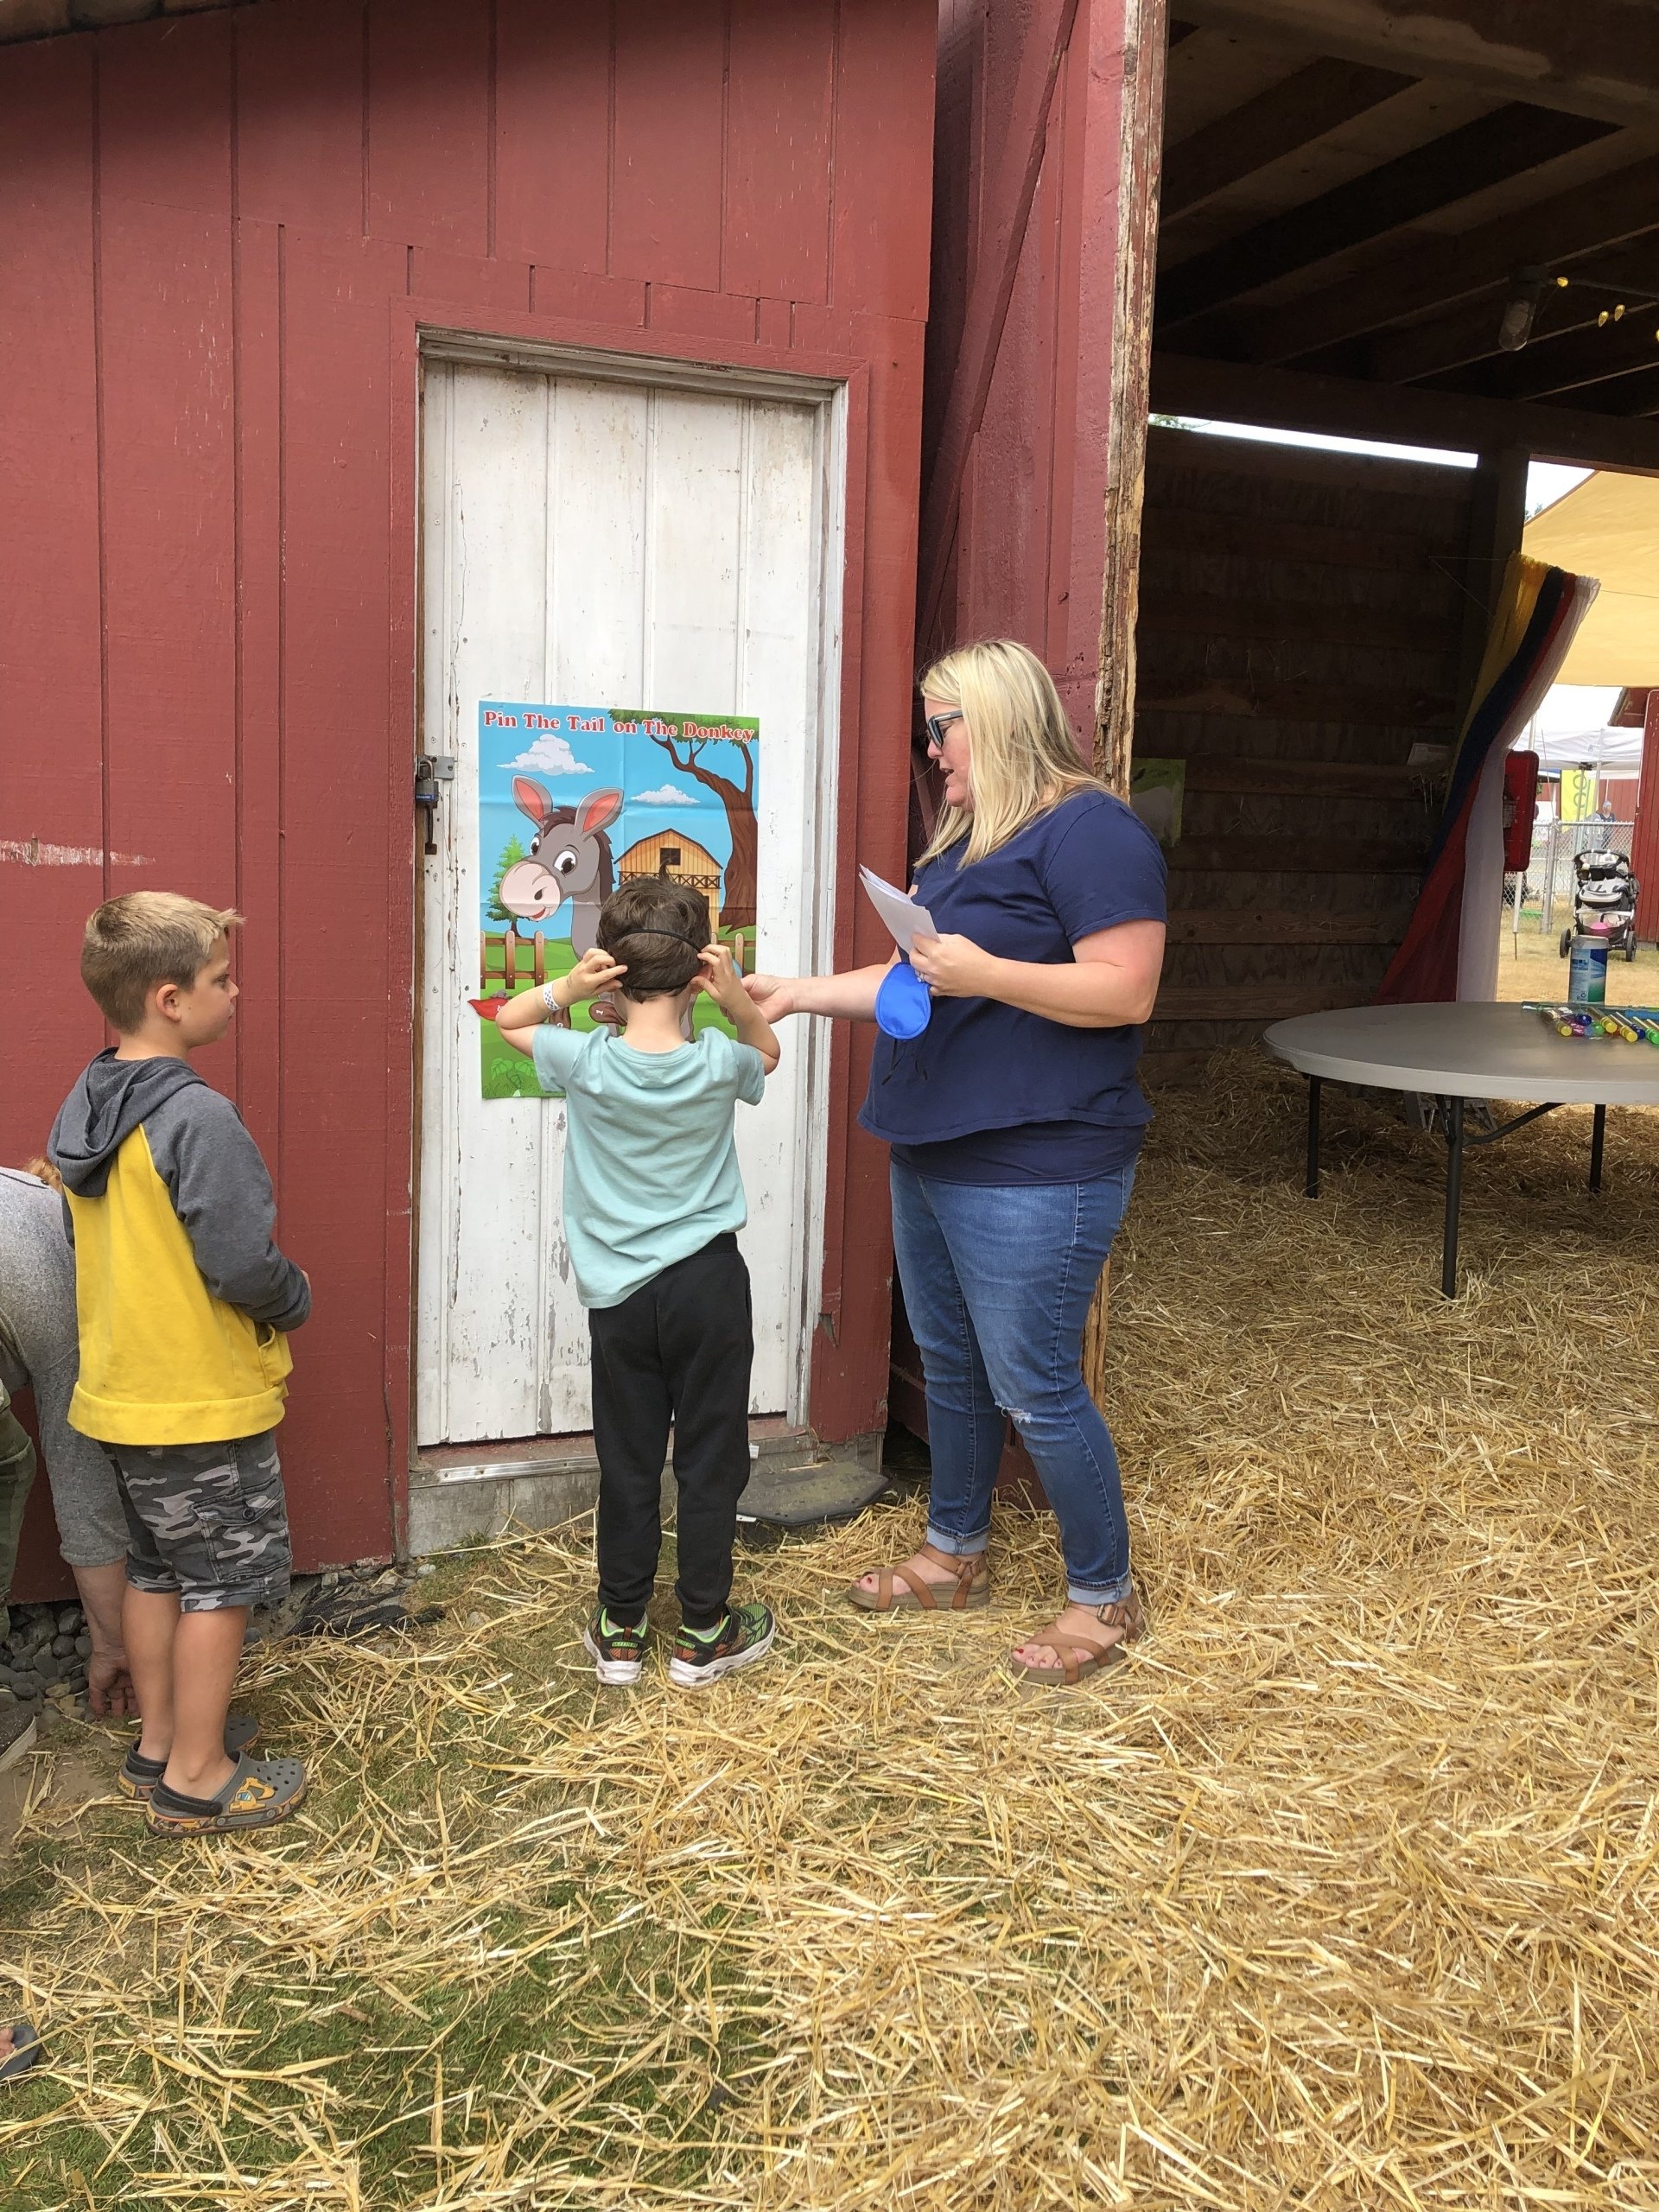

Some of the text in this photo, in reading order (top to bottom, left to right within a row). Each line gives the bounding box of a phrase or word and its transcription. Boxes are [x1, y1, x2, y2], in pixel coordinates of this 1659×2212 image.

[484, 710, 754, 742] Pin The Tail on The Donkey
